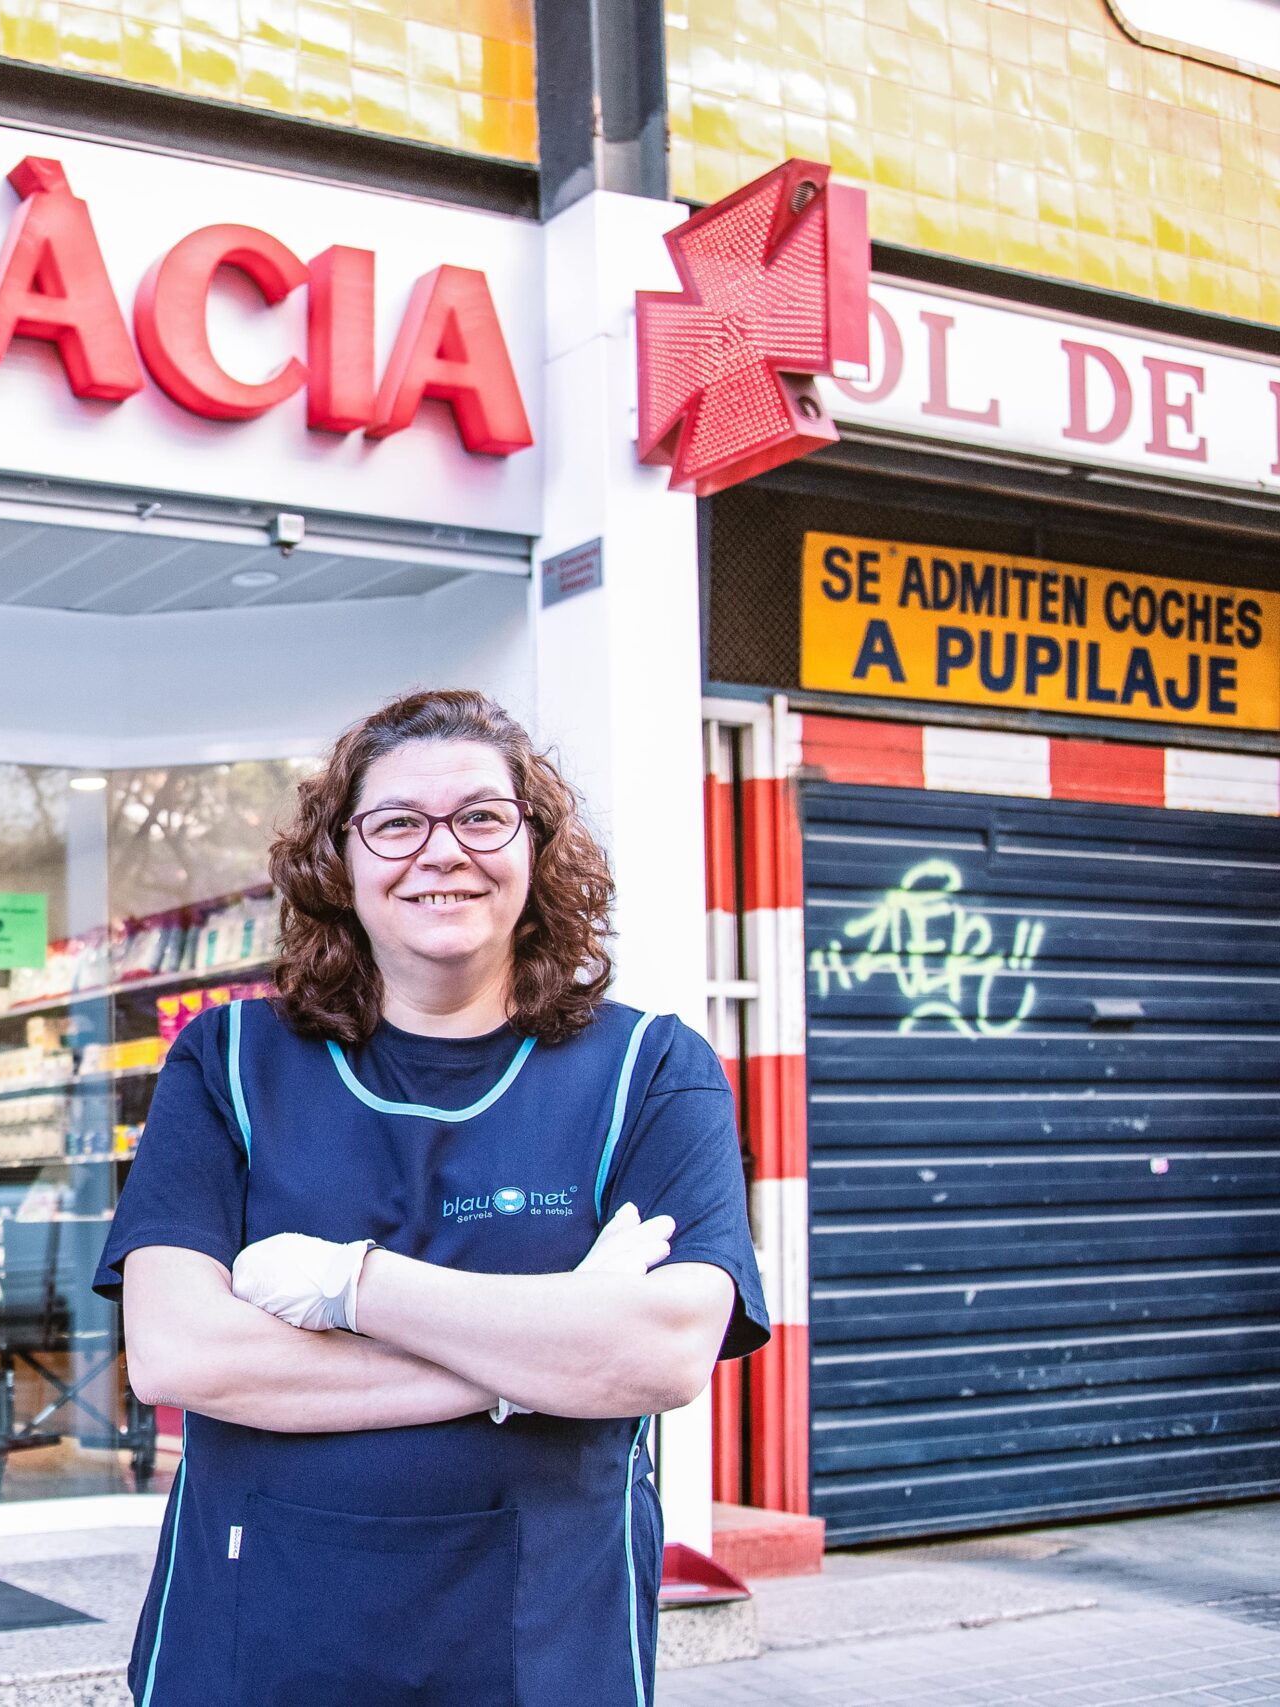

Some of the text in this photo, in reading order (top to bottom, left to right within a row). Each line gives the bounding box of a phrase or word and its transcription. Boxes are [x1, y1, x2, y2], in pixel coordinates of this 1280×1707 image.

[1061, 339, 1207, 463] DE
[821, 546, 1262, 649] SE ADMITEN COCHES
[852, 619, 1238, 715] A PUPILAJE
[442, 1195, 490, 1217] blau
[530, 1207, 541, 1215] de
[545, 1207, 573, 1216] neteja
